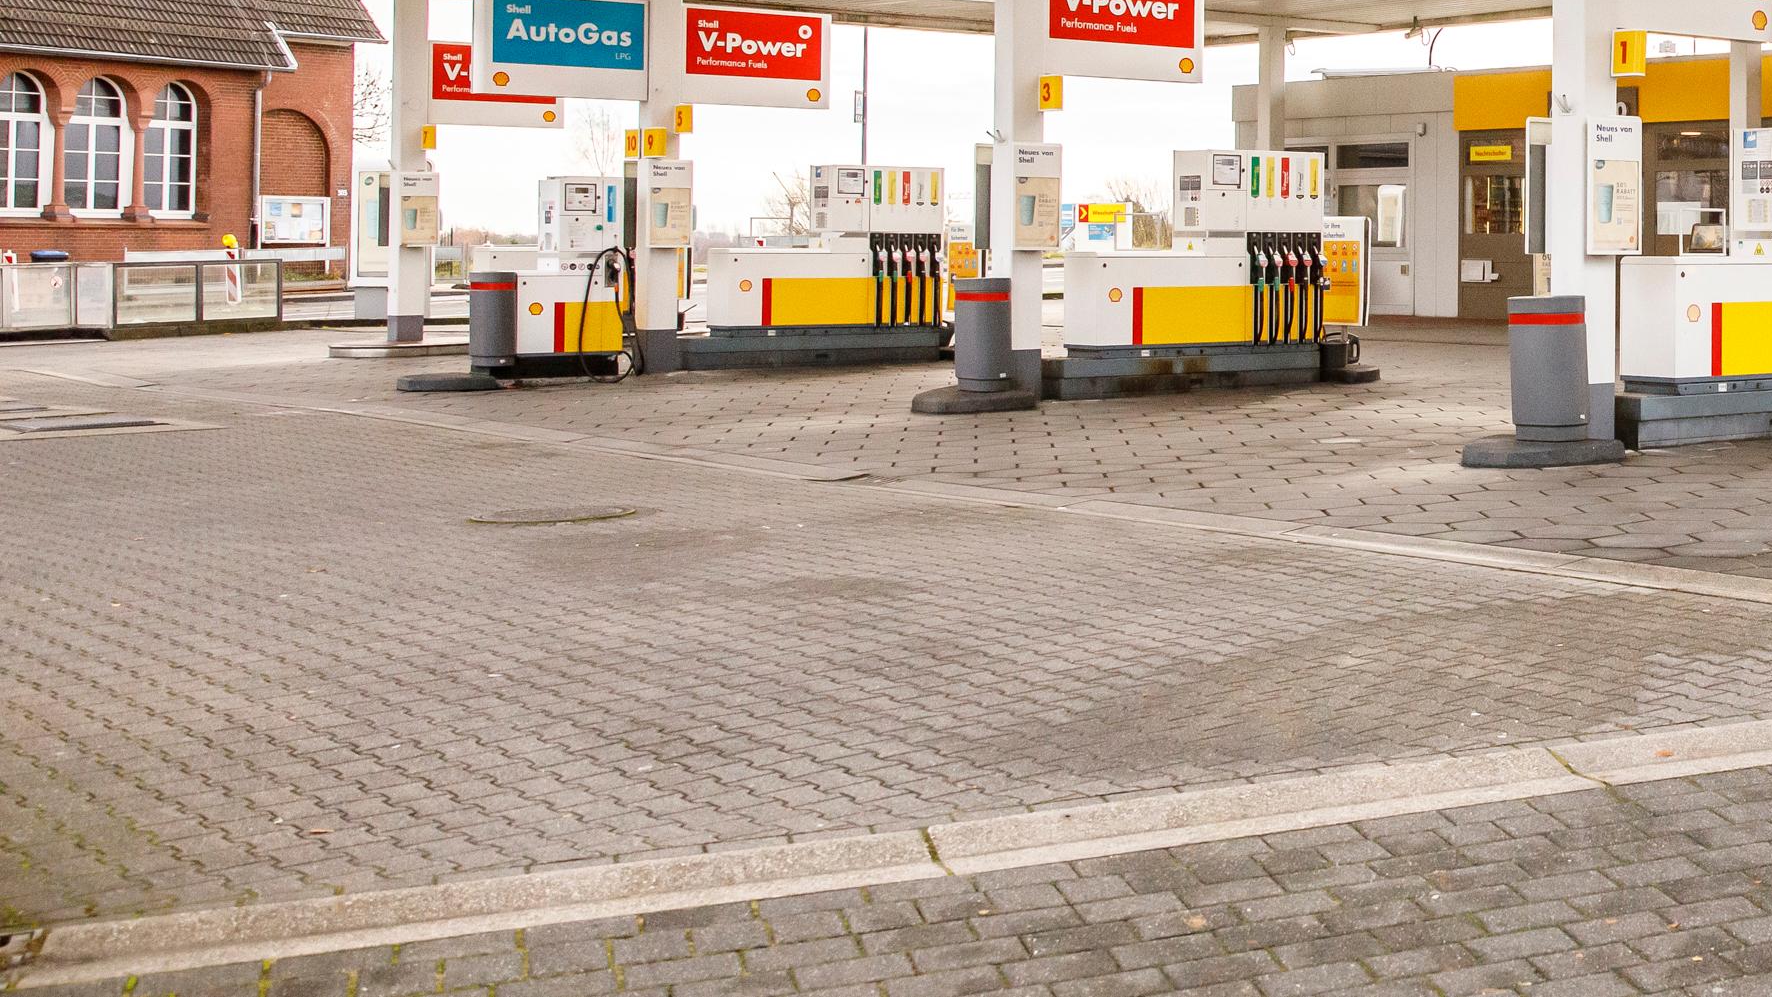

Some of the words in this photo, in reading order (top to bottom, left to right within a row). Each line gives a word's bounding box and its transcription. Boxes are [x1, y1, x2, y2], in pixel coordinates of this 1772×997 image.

[506, 4, 531, 14] Shell
[698, 19, 719, 29] Shell
[1061, 17, 1114, 32] Performance
[1116, 21, 1137, 33] Fuels
[506, 18, 632, 47] AutoGas
[698, 31, 807, 58] V-Power
[442, 53, 462, 61] Shell
[615, 52, 631, 61] LPG
[1620, 41, 1627, 64] 1
[696, 56, 746, 68] Performance
[748, 60, 768, 69] Fuels
[442, 84, 473, 93] Perform
[1042, 82, 1051, 102] 3
[677, 111, 683, 127] 5
[1596, 124, 1618, 133] Neues
[627, 135, 637, 151] 10
[647, 135, 654, 150] 9
[1596, 134, 1613, 143] Shell
